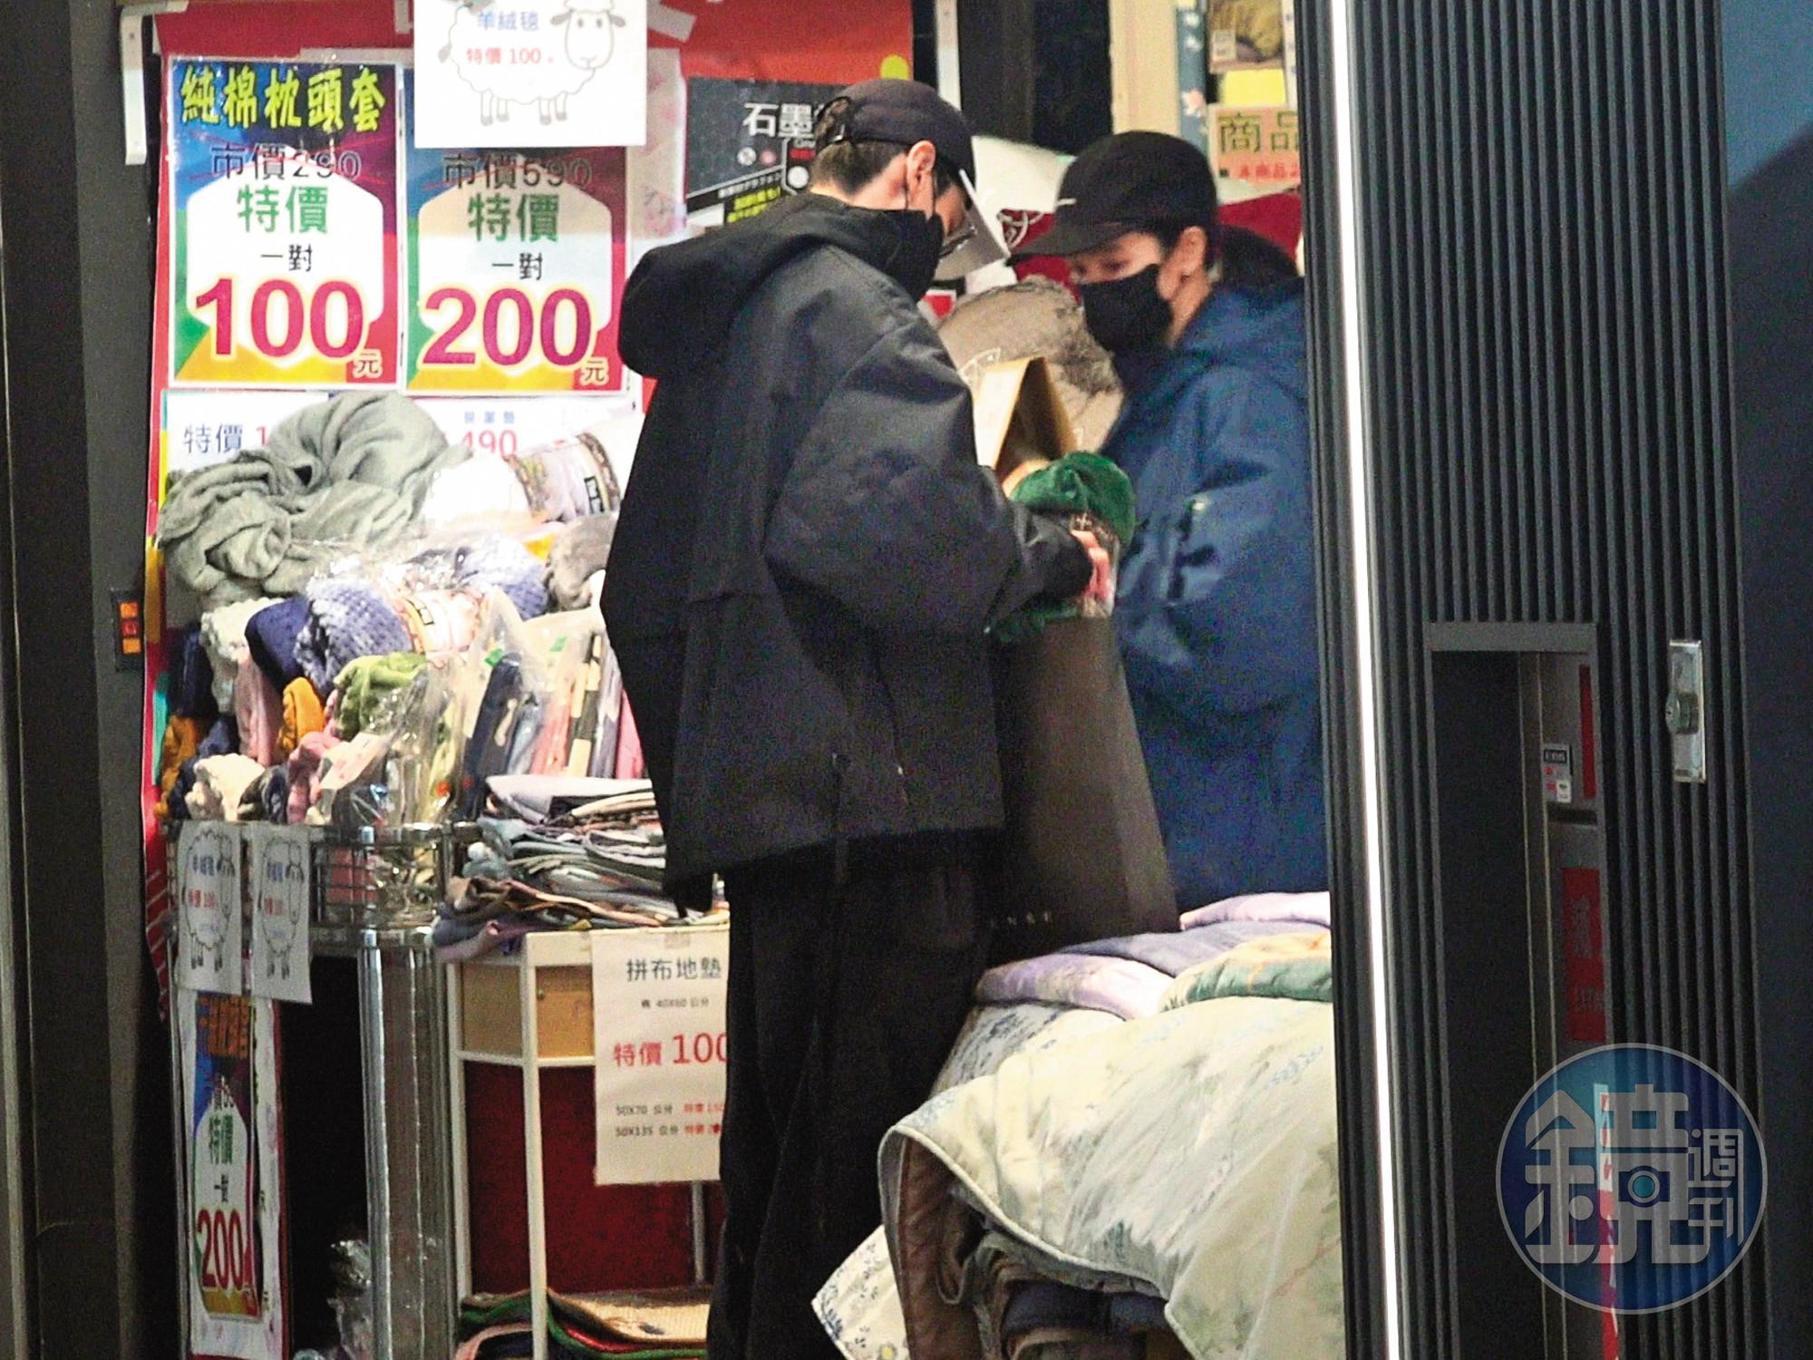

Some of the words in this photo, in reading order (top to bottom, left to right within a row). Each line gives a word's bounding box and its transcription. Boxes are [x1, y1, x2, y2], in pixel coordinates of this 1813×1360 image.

[466, 47, 502, 64] 特價
[181, 65, 386, 133] 純棉枕頭套
[742, 103, 825, 138] 石墨
[210, 141, 362, 181] 市價290
[443, 151, 593, 191] 市價590
[236, 184, 328, 234] 特價
[467, 192, 560, 243] 特價
[260, 244, 313, 272] 一對
[492, 252, 543, 281] 一對
[184, 423, 244, 455] 特價
[626, 956, 722, 982] 拼布地墊
[614, 1042, 662, 1066] 特價
